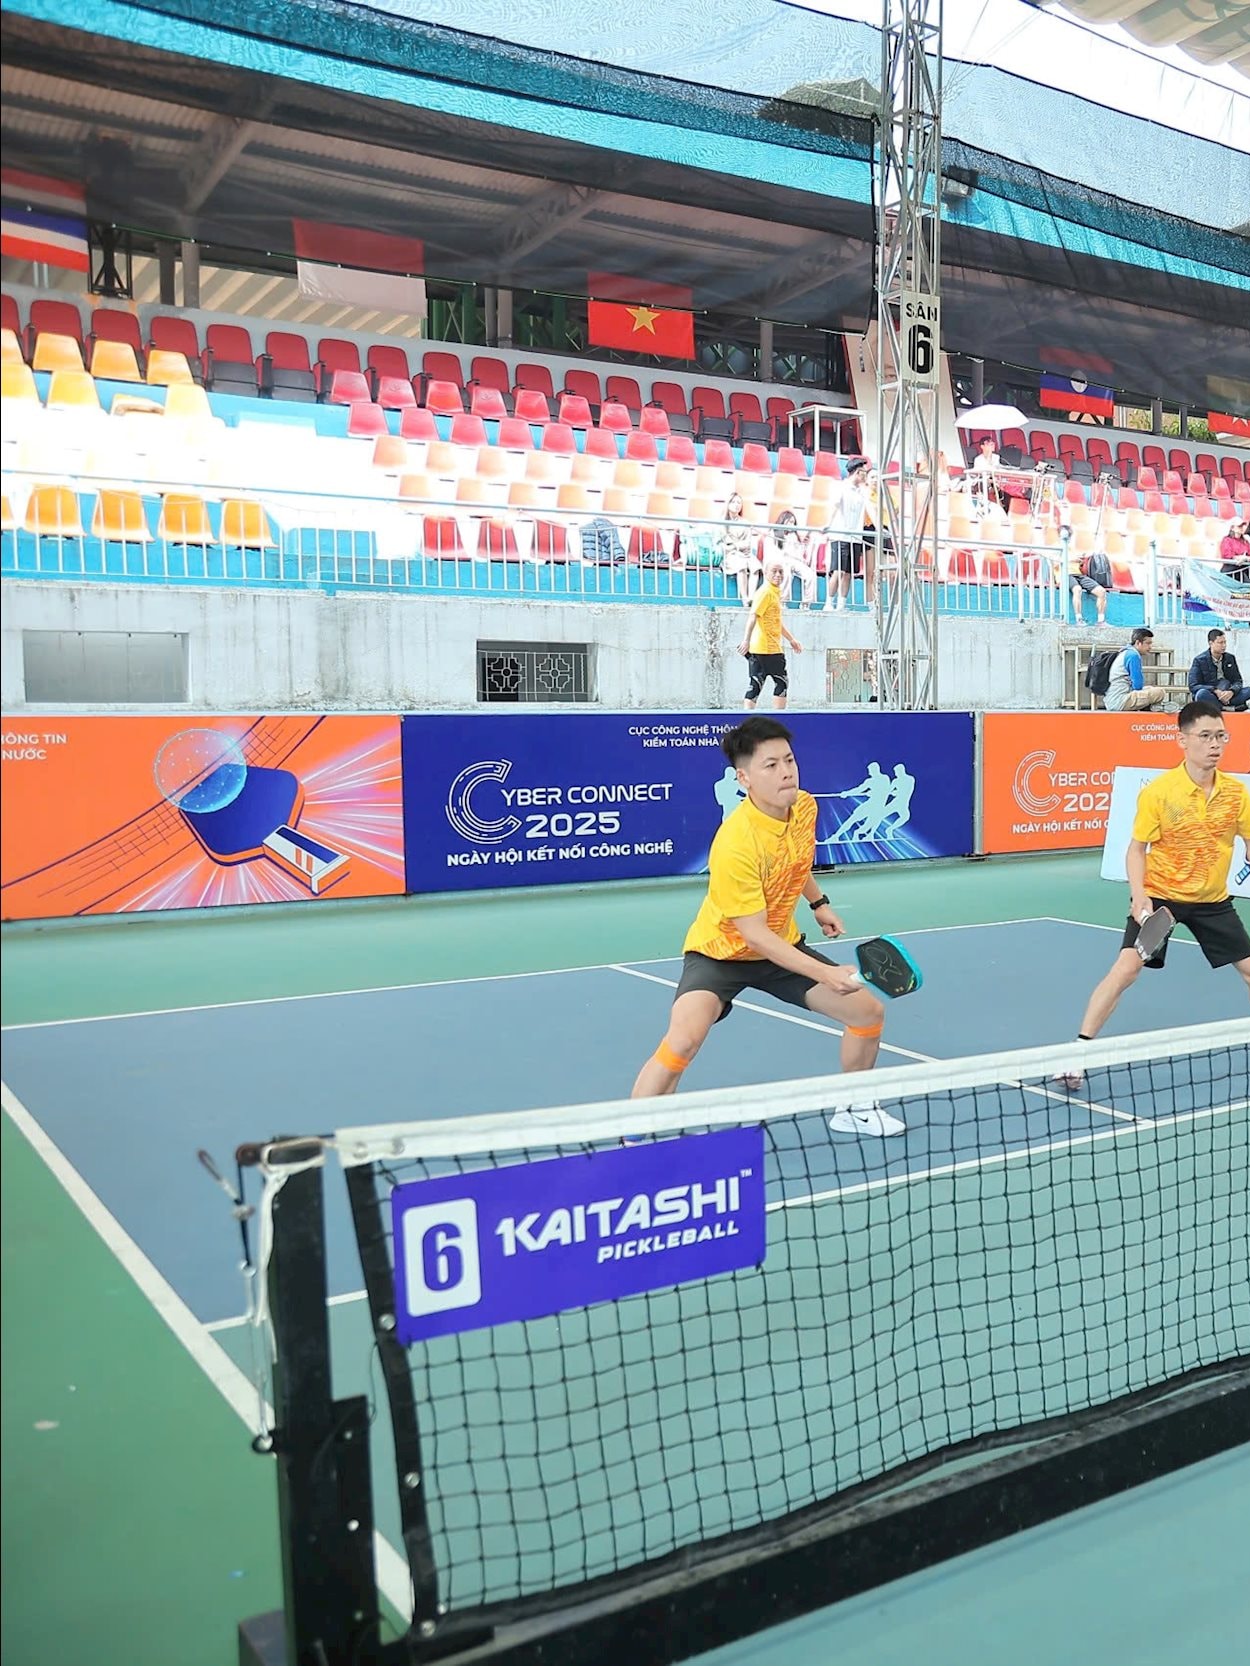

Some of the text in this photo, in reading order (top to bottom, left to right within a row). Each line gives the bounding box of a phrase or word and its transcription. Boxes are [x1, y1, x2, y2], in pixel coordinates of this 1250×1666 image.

[905, 301, 938, 321] SÂN
[908, 324, 934, 374] 6
[1, 731, 67, 745] ÔNG TIN
[628, 726, 650, 736] CỤC
[652, 725, 680, 735] CÔNG
[682, 724, 709, 736] NGHỆ
[643, 737, 719, 748] KIỂM TOÁN NHÀ
[3, 747, 47, 760] NƯỚC
[567, 783, 673, 803] CONNECT
[1063, 792, 1111, 812] 202
[525, 811, 621, 839] 2025
[1013, 822, 1040, 834] NGÀY
[1043, 819, 1061, 834] HỘI
[1063, 818, 1082, 831] KẾT
[1085, 817, 1102, 830] NỐI
[447, 839, 673, 866] NGÀY HỘI KẾT NỐI CÔNG NGHỆ
[597, 1219, 740, 1264] PICKLEBALL
[422, 1221, 465, 1293] 6
